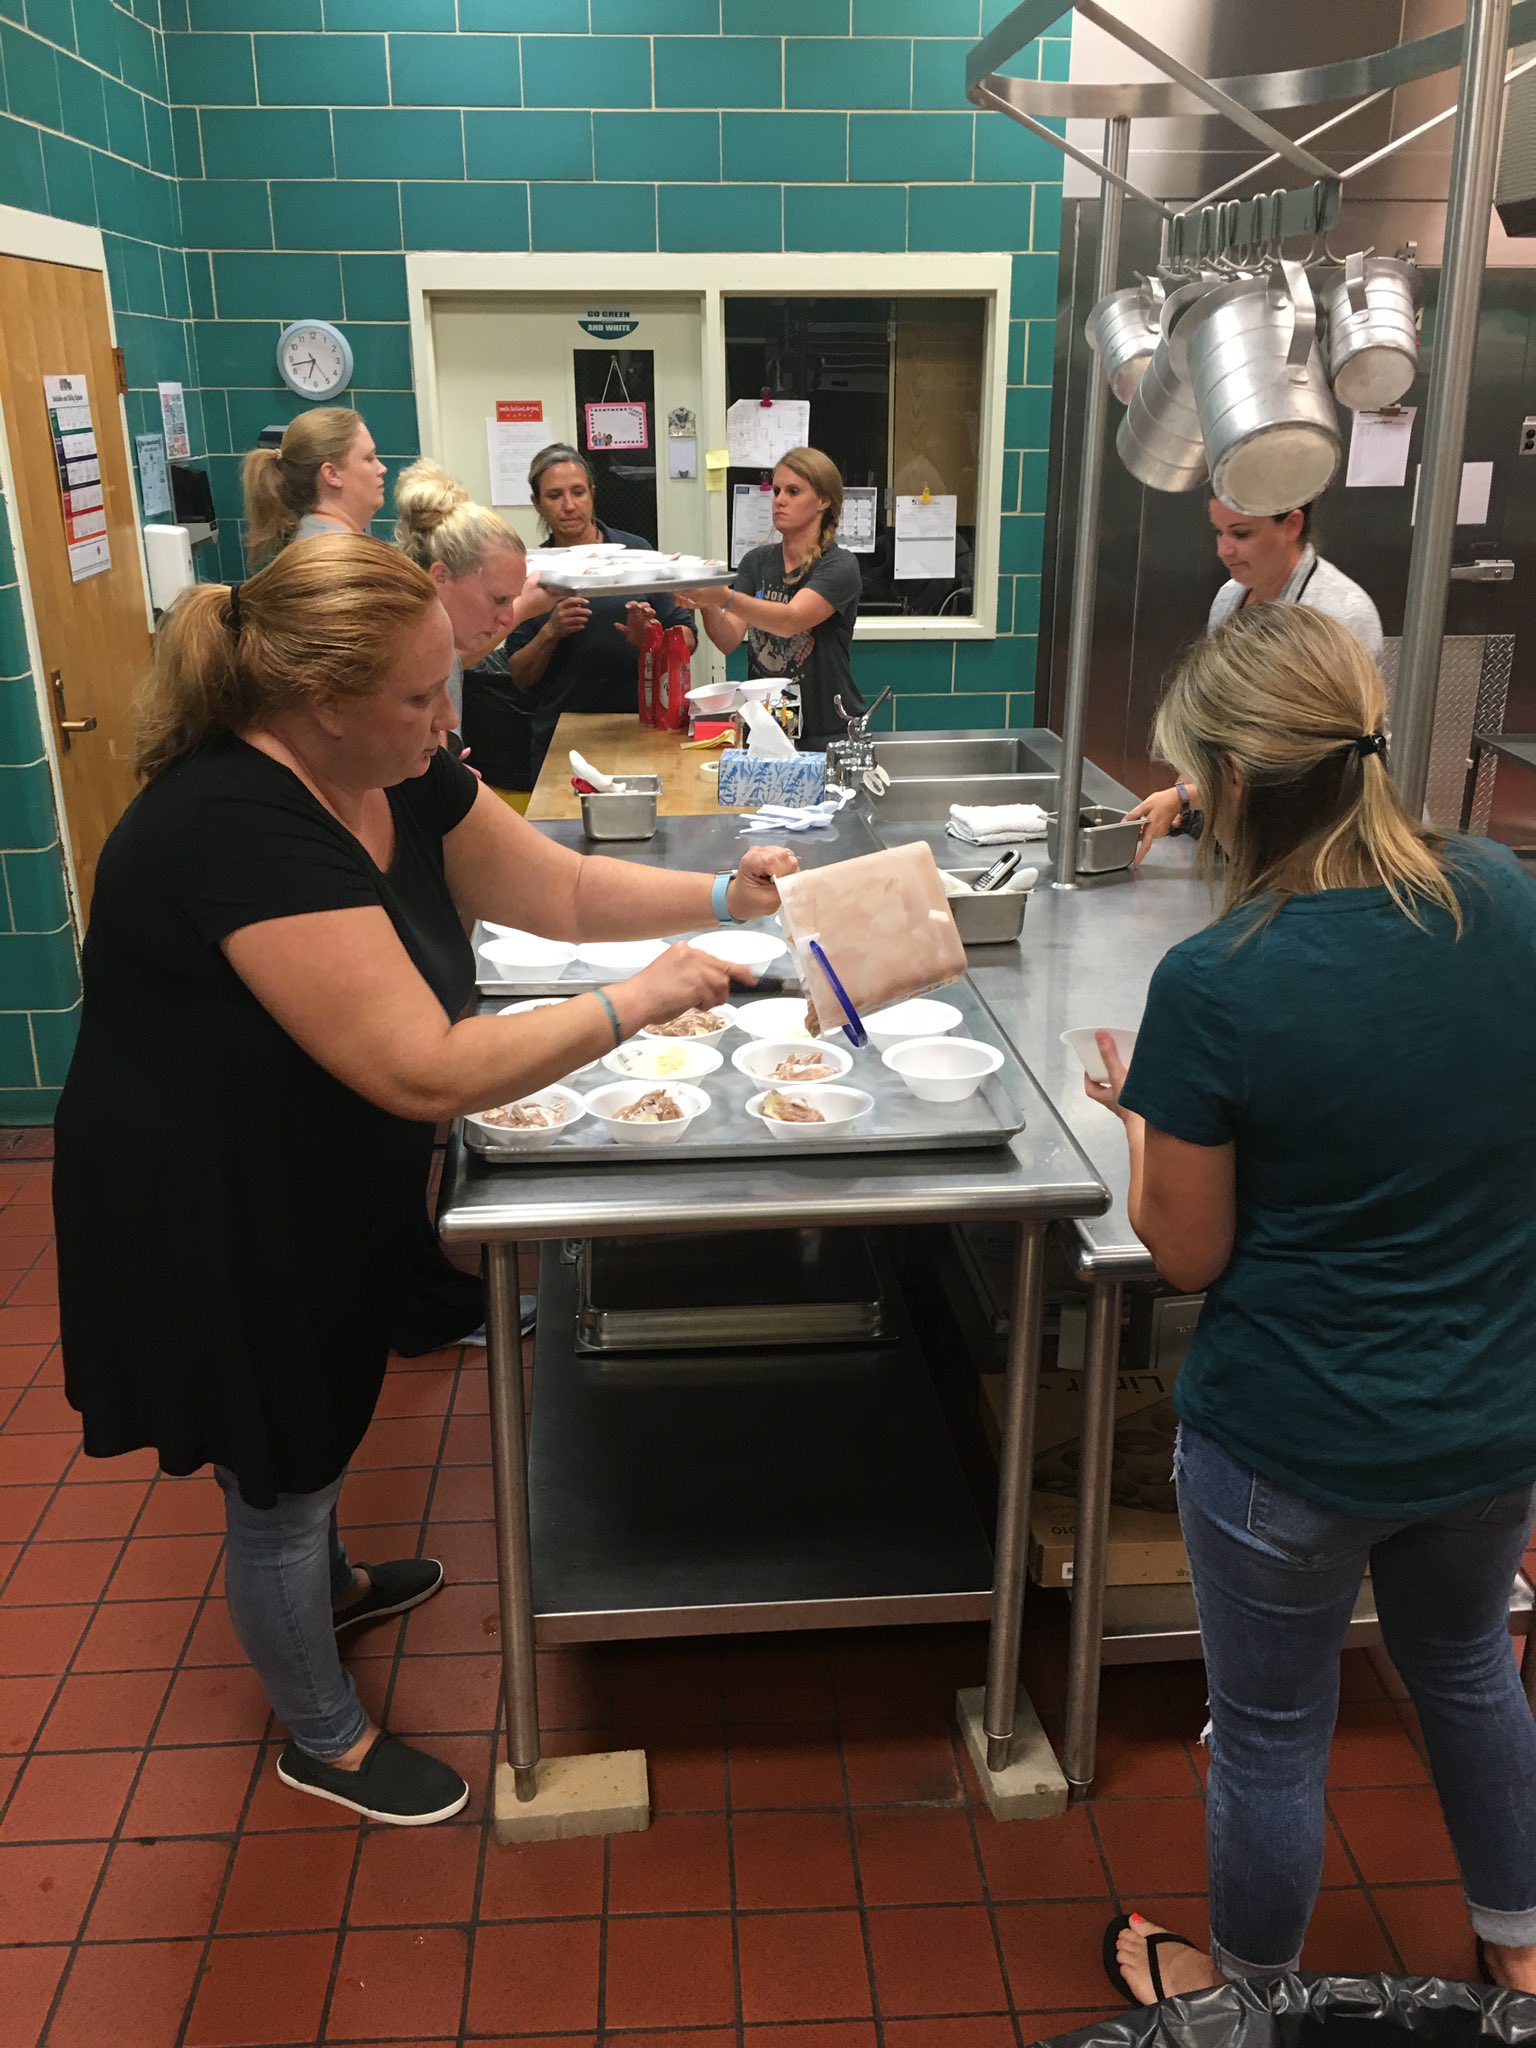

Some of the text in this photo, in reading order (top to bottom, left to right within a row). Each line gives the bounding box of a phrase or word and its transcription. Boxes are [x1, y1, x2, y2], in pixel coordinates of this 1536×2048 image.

[298, 335, 305, 343] 11
[309, 331, 317, 340] 12
[323, 336, 327, 344] 1
[290, 343, 298, 351] 10
[331, 344, 337, 353] 2
[288, 355, 294, 363] 9
[335, 357, 341, 365] 3
[313, 380, 319, 388] 6
[325, 377, 331, 385] 5
